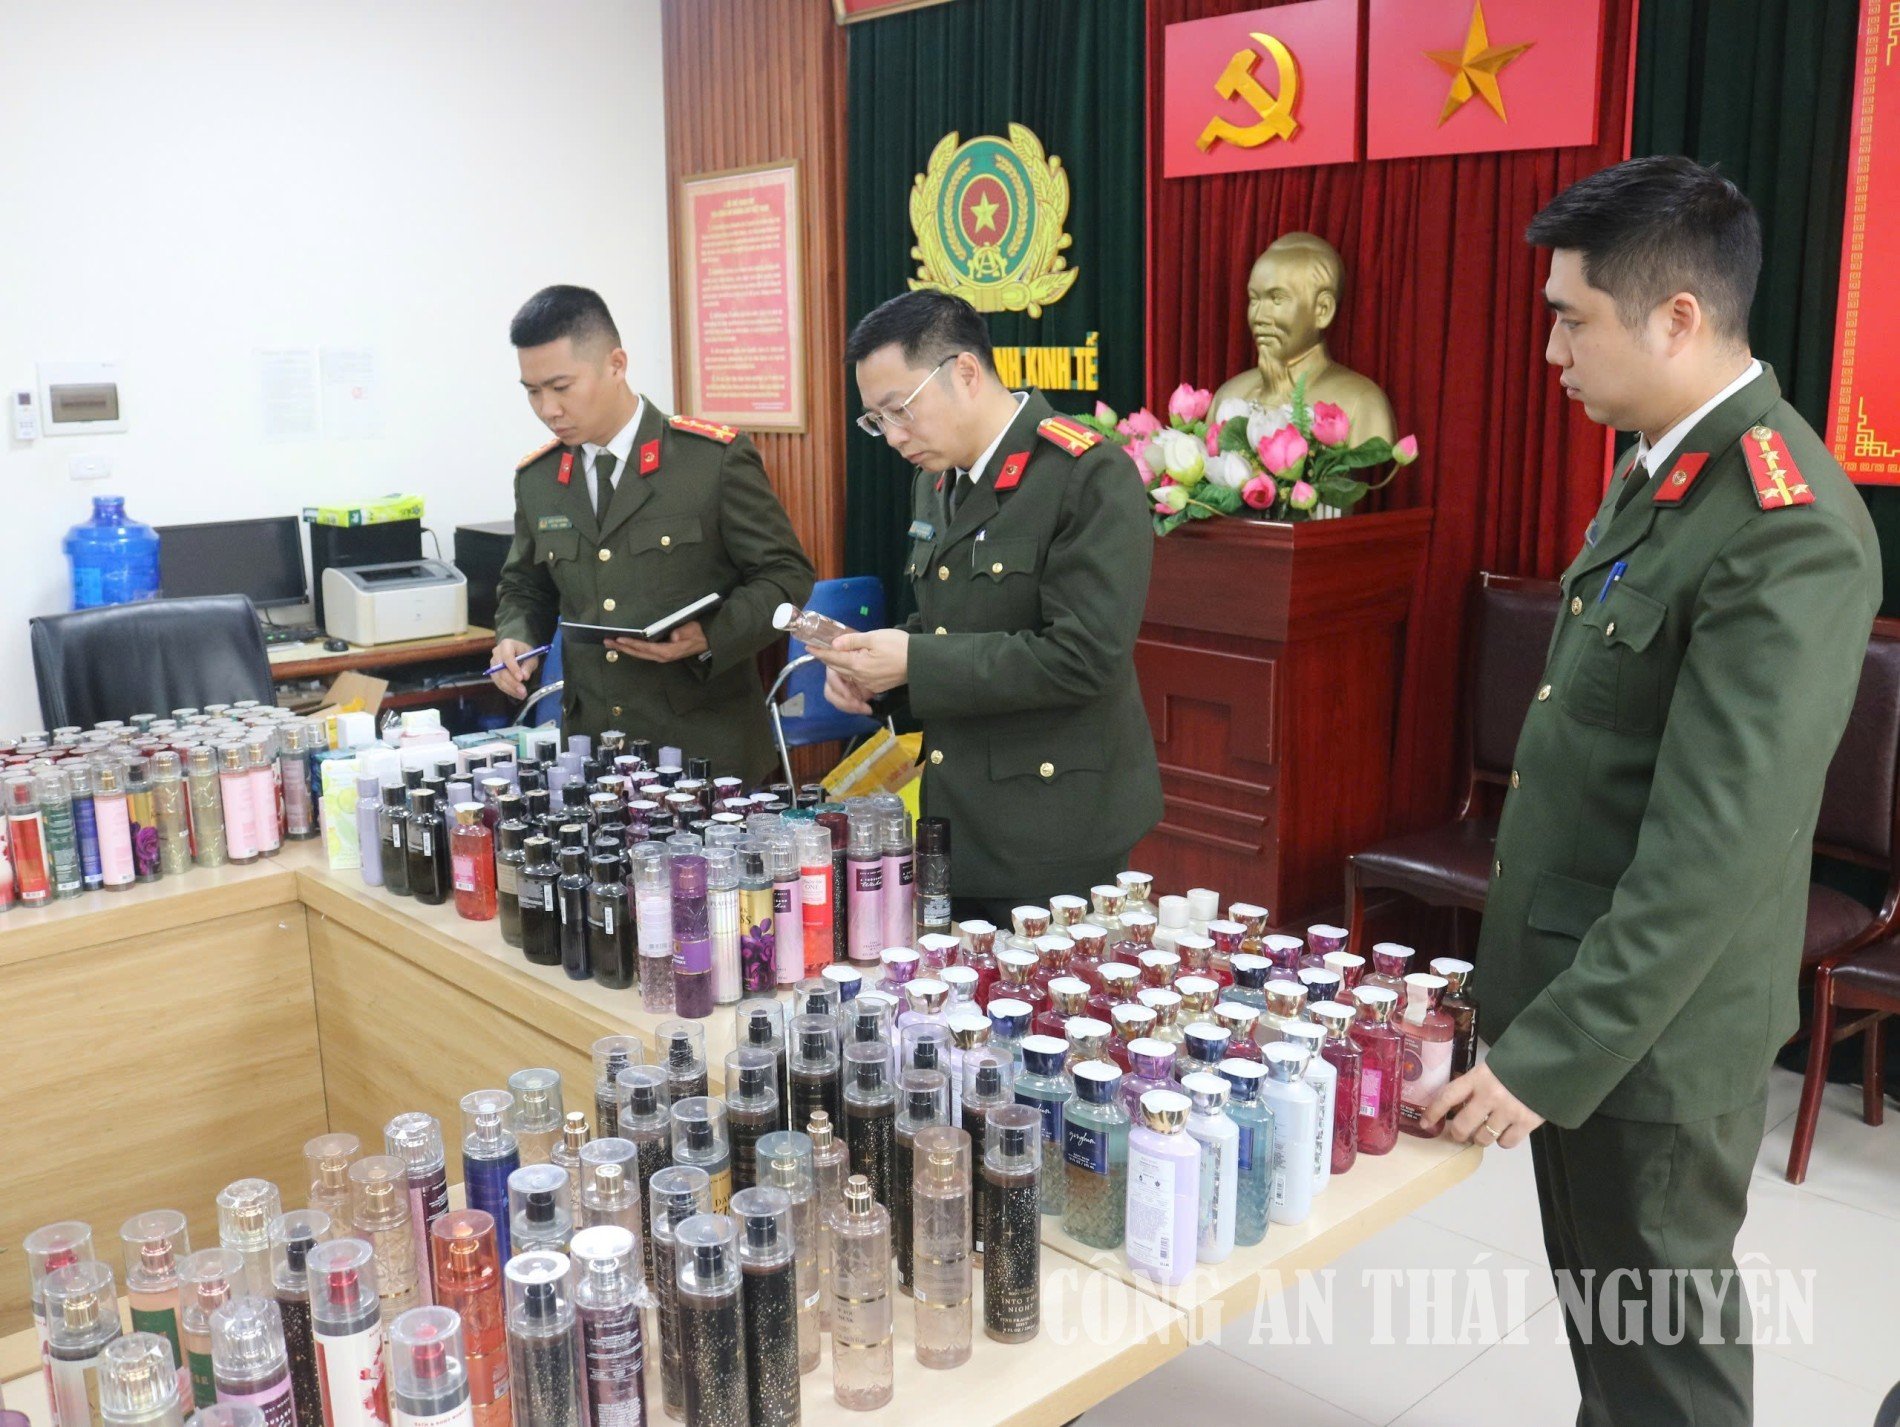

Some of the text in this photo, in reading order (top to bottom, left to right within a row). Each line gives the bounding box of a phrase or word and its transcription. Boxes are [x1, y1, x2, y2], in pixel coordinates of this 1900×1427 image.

[992, 331, 1099, 390] NH KINH TẾ
[1001, 1297, 1023, 1305] INTO
[1008, 1303, 1034, 1313] NIGHT
